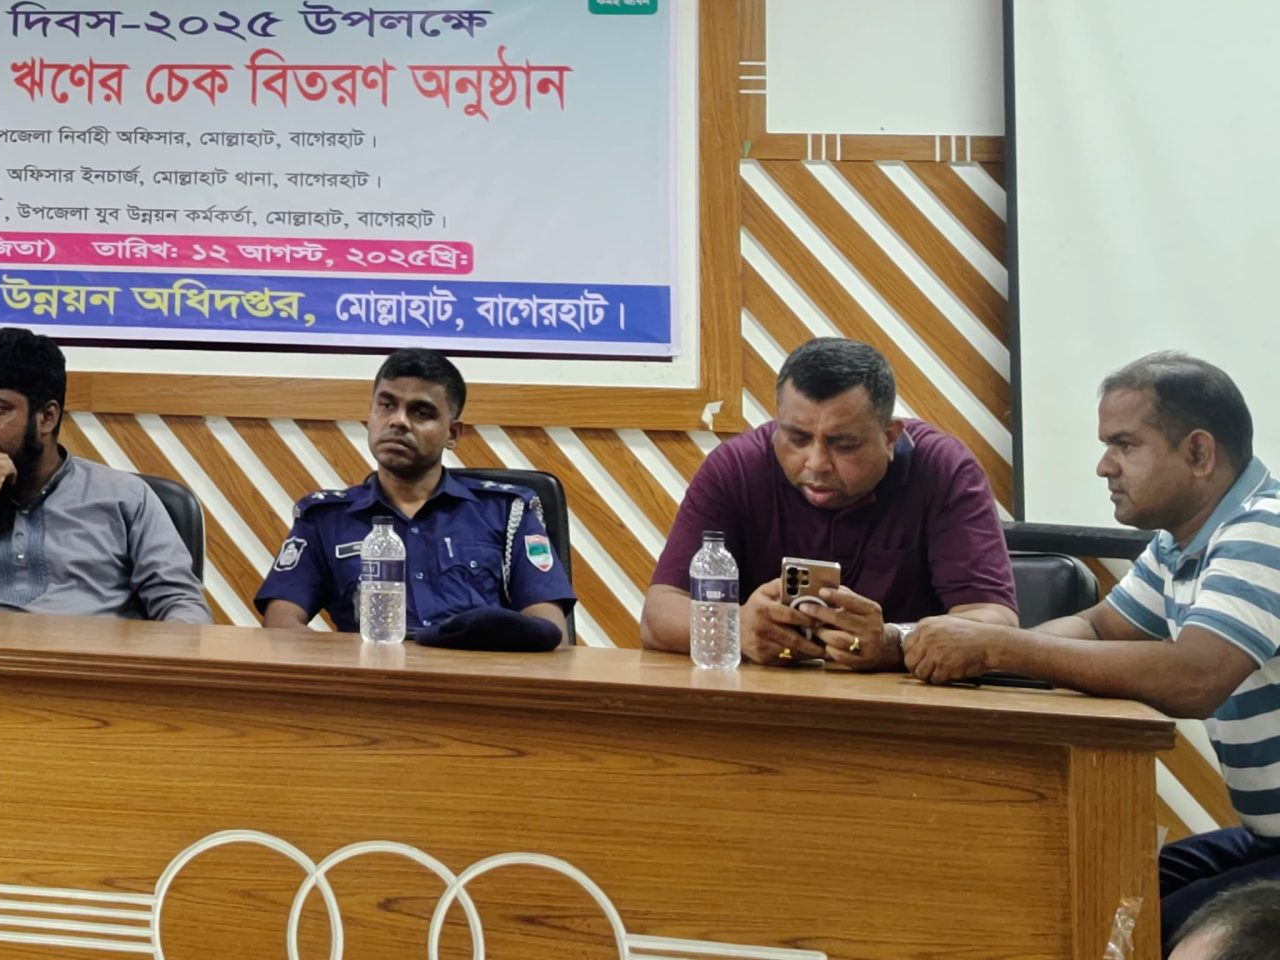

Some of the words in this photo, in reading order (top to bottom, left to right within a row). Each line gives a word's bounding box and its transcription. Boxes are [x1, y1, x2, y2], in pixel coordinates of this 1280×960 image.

[6, 1, 282, 41] দিবস-২০২৫
[298, 0, 494, 39] উপলক্ষে
[10, 56, 131, 106] ঋণের
[146, 64, 234, 107] চেক
[245, 47, 397, 109] বিতরণ
[408, 44, 574, 122] অনুষ্ঠান
[116, 127, 192, 148] অফিসার,
[200, 128, 282, 150] মোল্লাহাট,
[288, 128, 367, 149] বাগেরহাট
[6, 165, 75, 183] অফিসার
[80, 165, 144, 187] ইনচার্জ,
[153, 168, 228, 187] মোল্লাহাট
[235, 170, 278, 189] থানা,
[285, 170, 370, 189] বাগেরহাট
[17, 202, 89, 221] উপজেলা
[95, 207, 121, 225] যুব
[126, 204, 179, 224] উন্নয়ন
[185, 204, 257, 227] কর্মকর্তা,
[266, 208, 349, 230] মোল্লাহাট,
[356, 208, 435, 229] বাগেরহাট
[192, 244, 230, 264] ১২
[237, 240, 334, 267] আগস্ট,
[130, 278, 316, 328] অধিদপ্তর,
[336, 285, 465, 332] মোল্লাহাট,
[473, 285, 610, 333] বাগেরহাট
